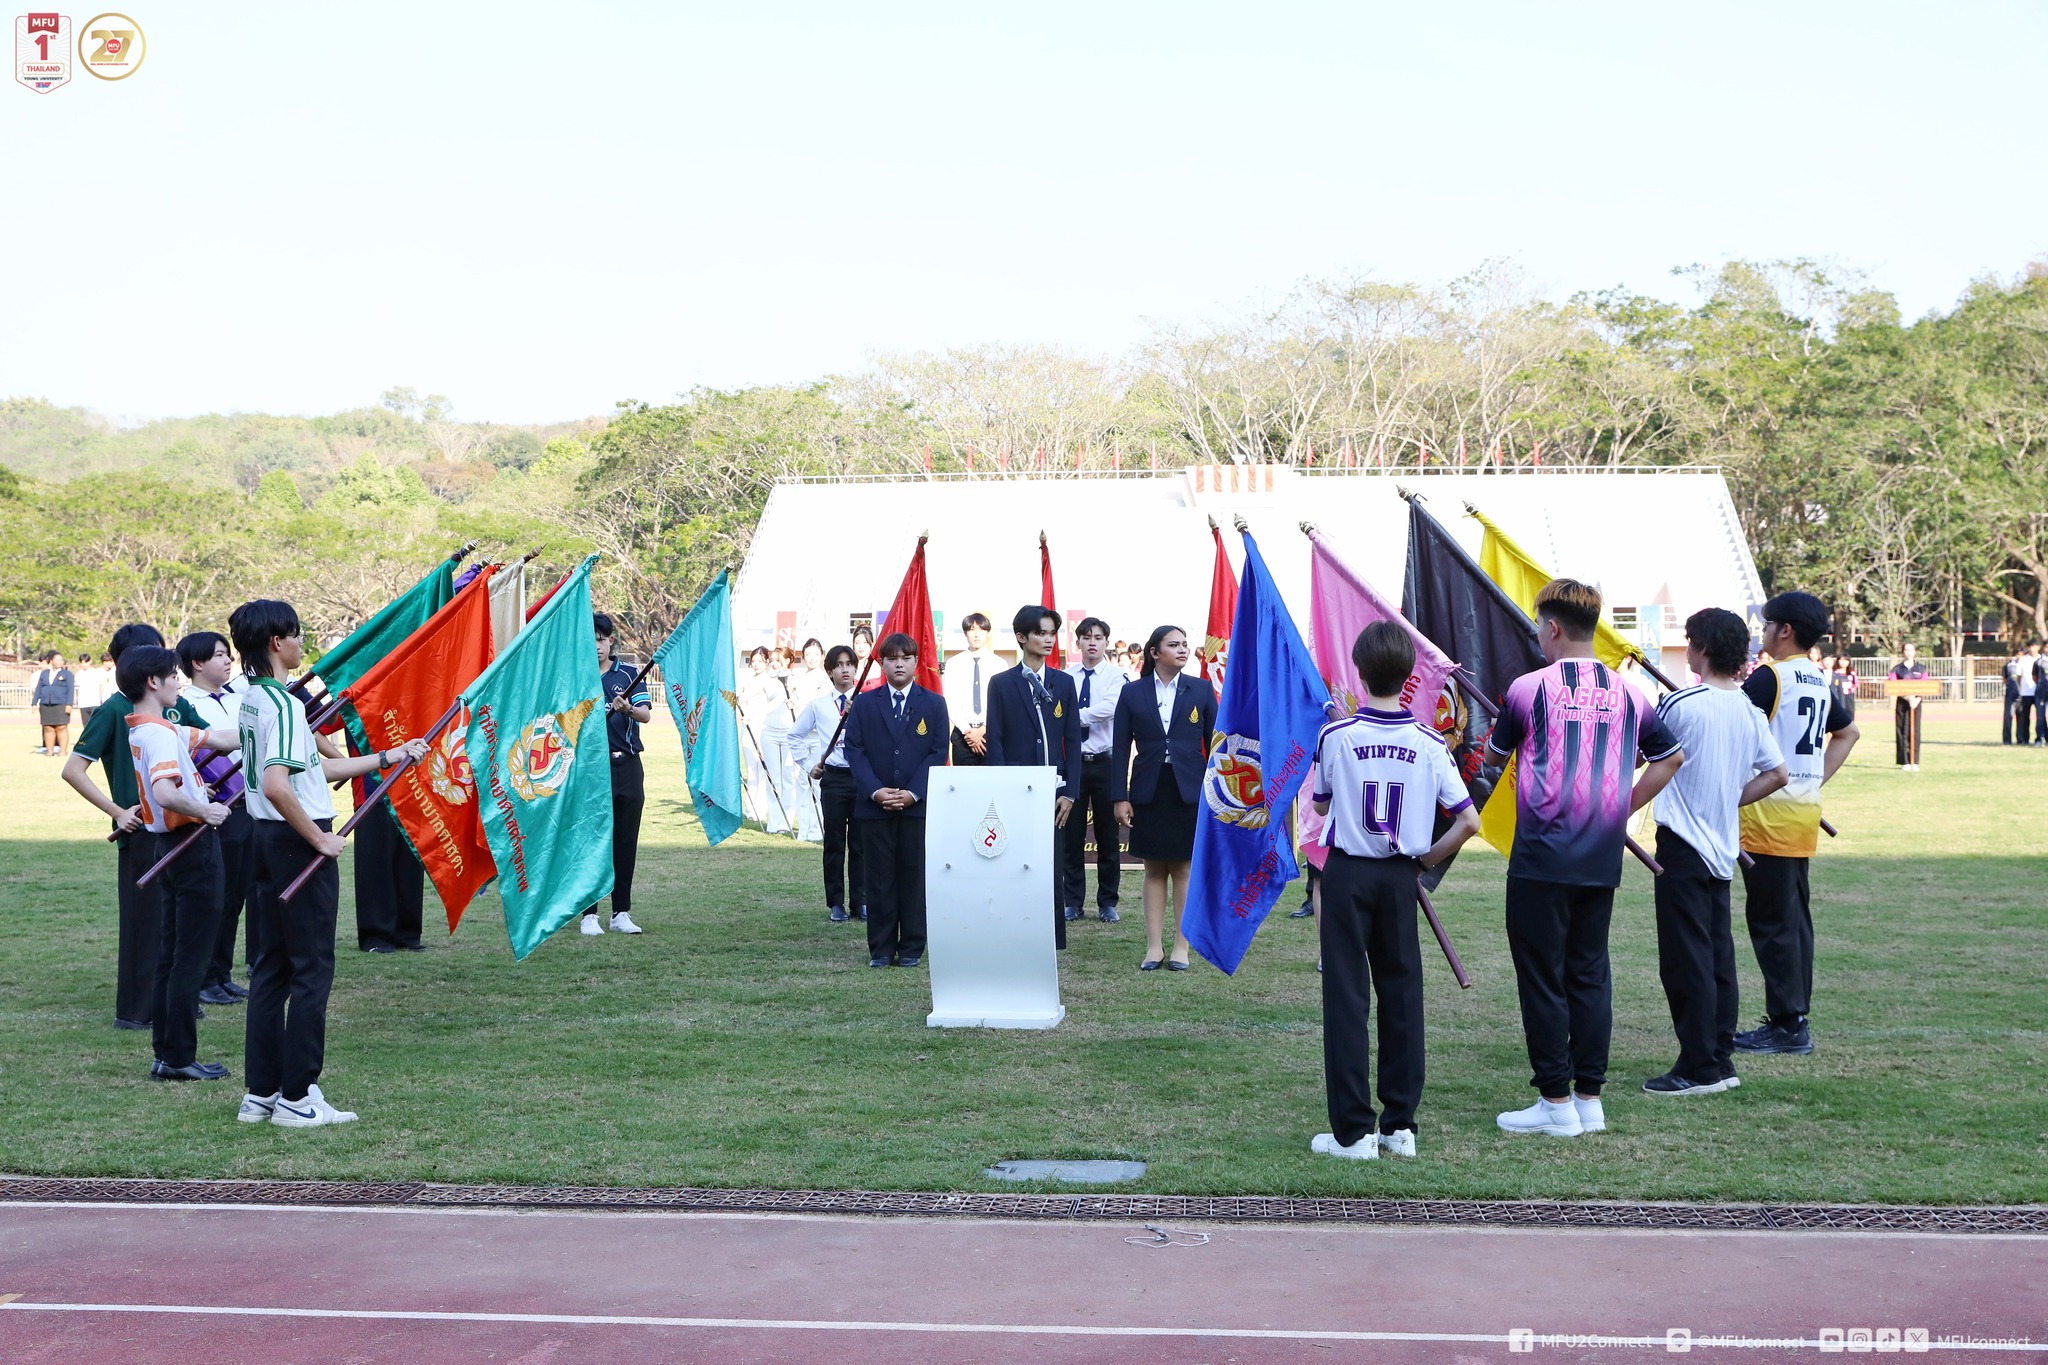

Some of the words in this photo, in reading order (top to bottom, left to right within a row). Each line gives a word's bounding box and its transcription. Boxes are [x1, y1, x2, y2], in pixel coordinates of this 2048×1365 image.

[1552, 686, 1621, 709] AGRO
[1556, 709, 1618, 723] INDUSTRY
[1353, 745, 1417, 764] WINTER
[1363, 781, 1405, 853] 4
